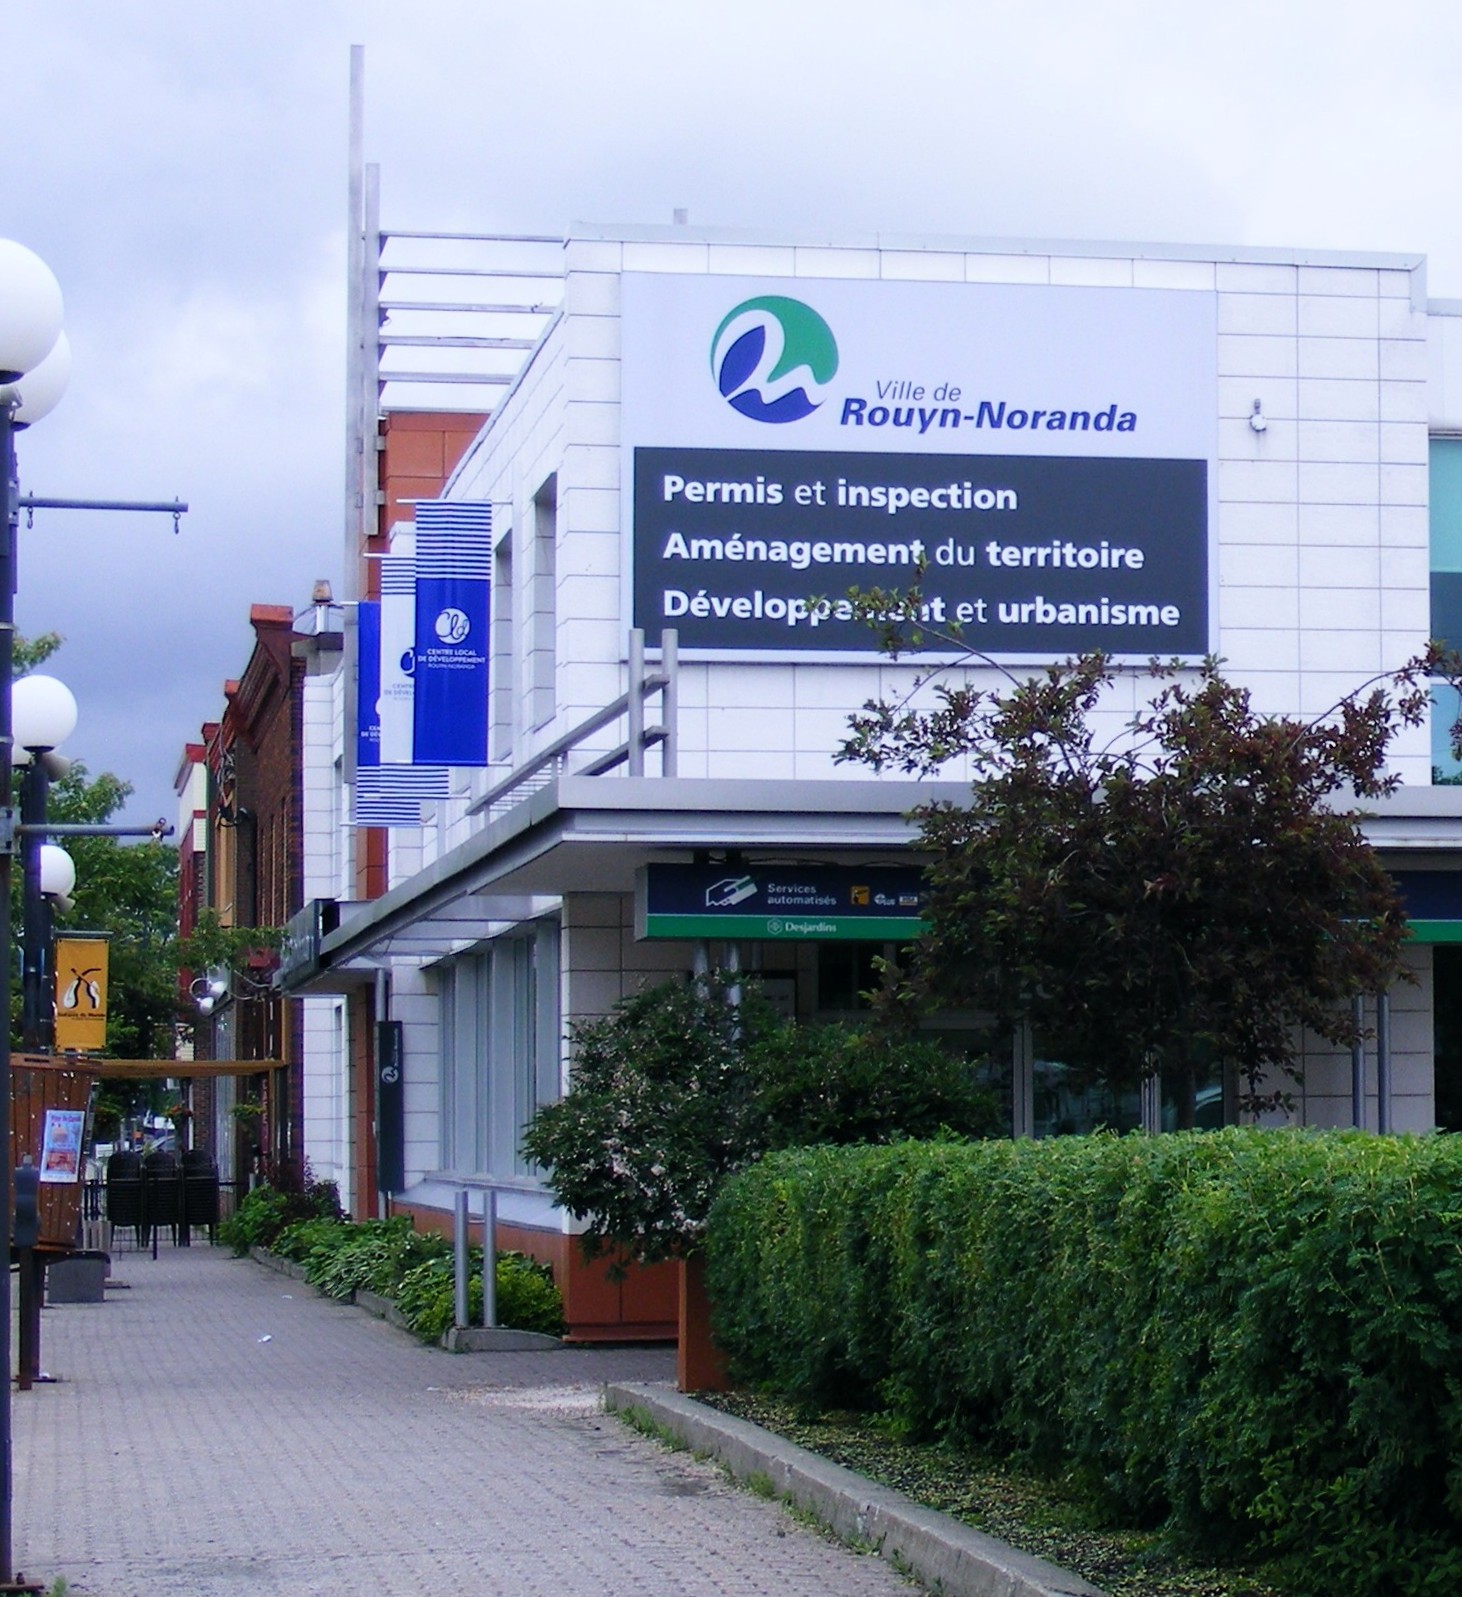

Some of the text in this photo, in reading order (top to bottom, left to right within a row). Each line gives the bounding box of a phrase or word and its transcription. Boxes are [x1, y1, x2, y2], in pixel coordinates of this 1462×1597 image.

[876, 380, 962, 402] Ville de
[840, 397, 1137, 434] Rouyn-Noranda
[663, 475, 1018, 515] Permis et inspection
[663, 532, 1145, 570] Aménagement du territoire
[956, 598, 988, 623] et
[998, 596, 1181, 626] urbanisme
[417, 655, 427, 663] DE
[427, 648, 453, 656] CENTRE
[767, 883, 817, 894] Services
[767, 895, 837, 906] automatisés
[785, 921, 837, 935] Desjardins
